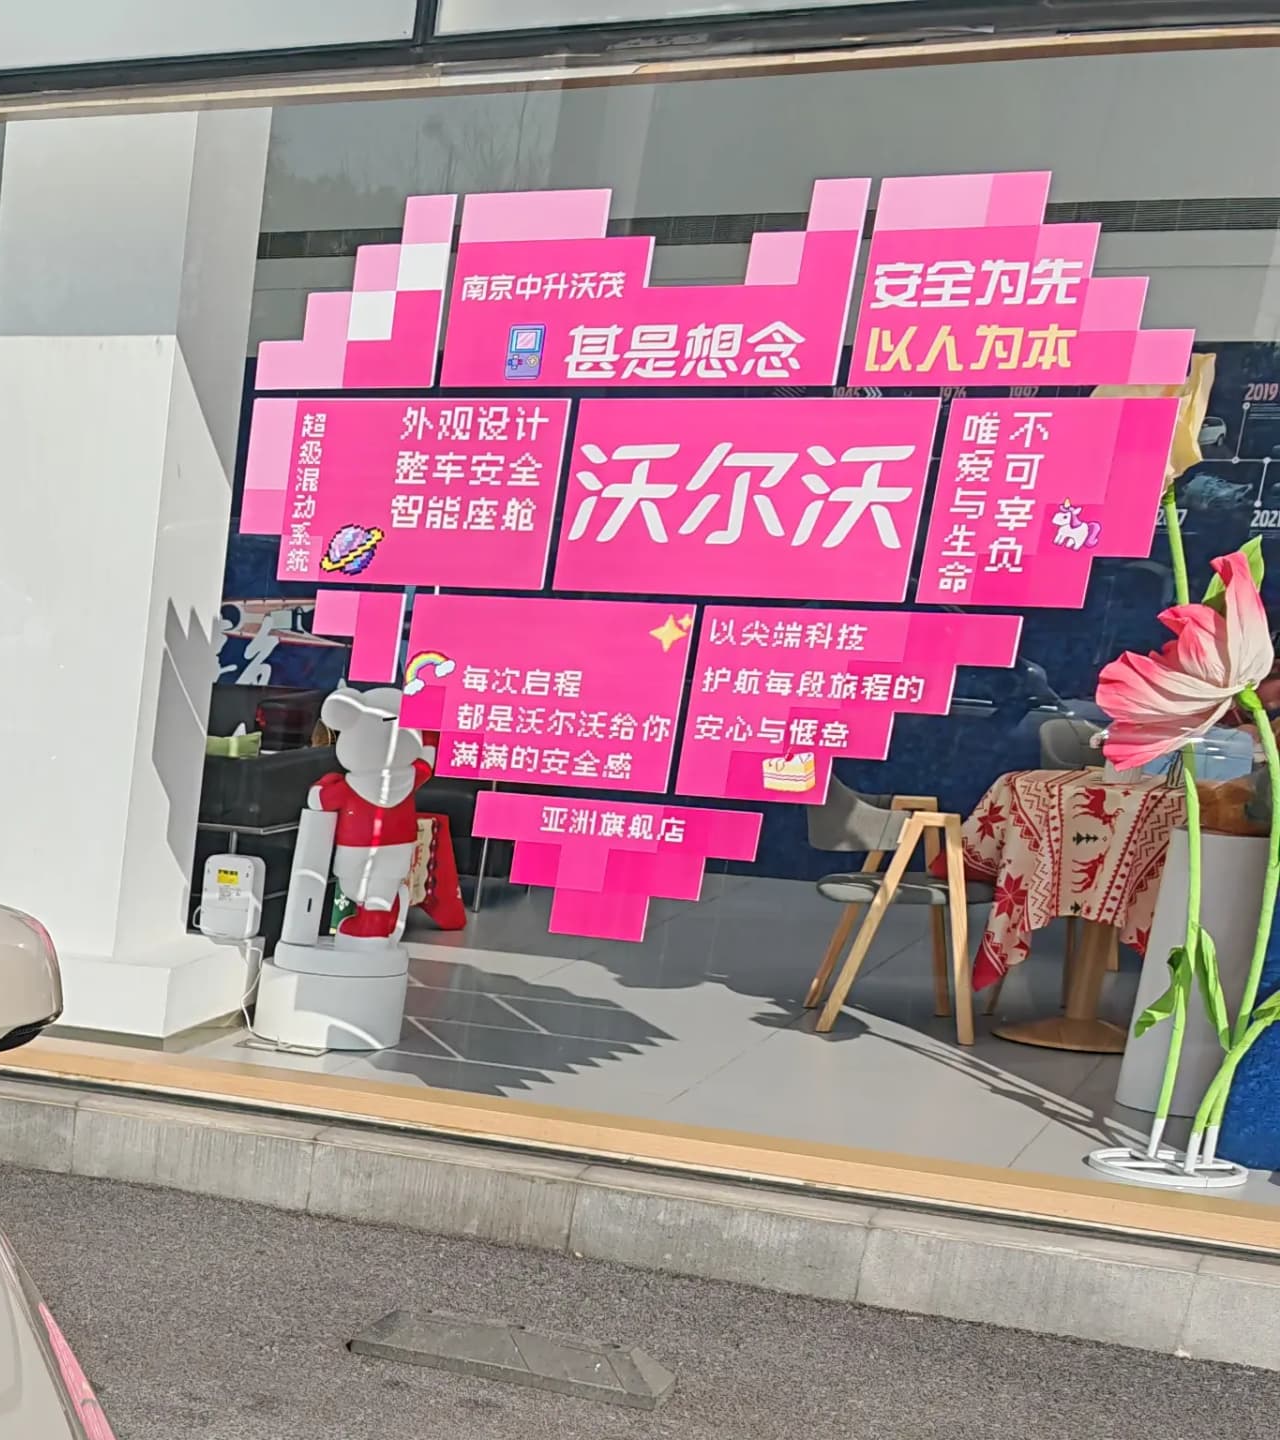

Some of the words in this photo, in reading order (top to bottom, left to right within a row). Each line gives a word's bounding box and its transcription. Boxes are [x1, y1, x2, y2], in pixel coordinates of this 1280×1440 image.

[462, 271, 627, 301] 南京中升沃茂
[870, 258, 1083, 309] 安全为先
[563, 320, 806, 380] 甚是想念
[864, 323, 1078, 372] 以人为本
[400, 406, 550, 441] 外观设计
[395, 451, 543, 487] 整车安全
[286, 413, 328, 573] 超级混动系统
[568, 442, 915, 549] 沃尔沃
[938, 412, 1001, 593] 唯爱与生命
[390, 494, 536, 532] 智能座舱
[709, 618, 868, 650] 以尖端科技
[462, 665, 583, 698] 每次启程
[701, 666, 925, 702] 护航每段旅程的
[456, 703, 672, 742] 都是沃尔沃给你
[694, 714, 850, 748] 安心与惬意
[450, 740, 634, 780] 满满的安全感
[540, 806, 686, 843] 亚洲旗舰店
